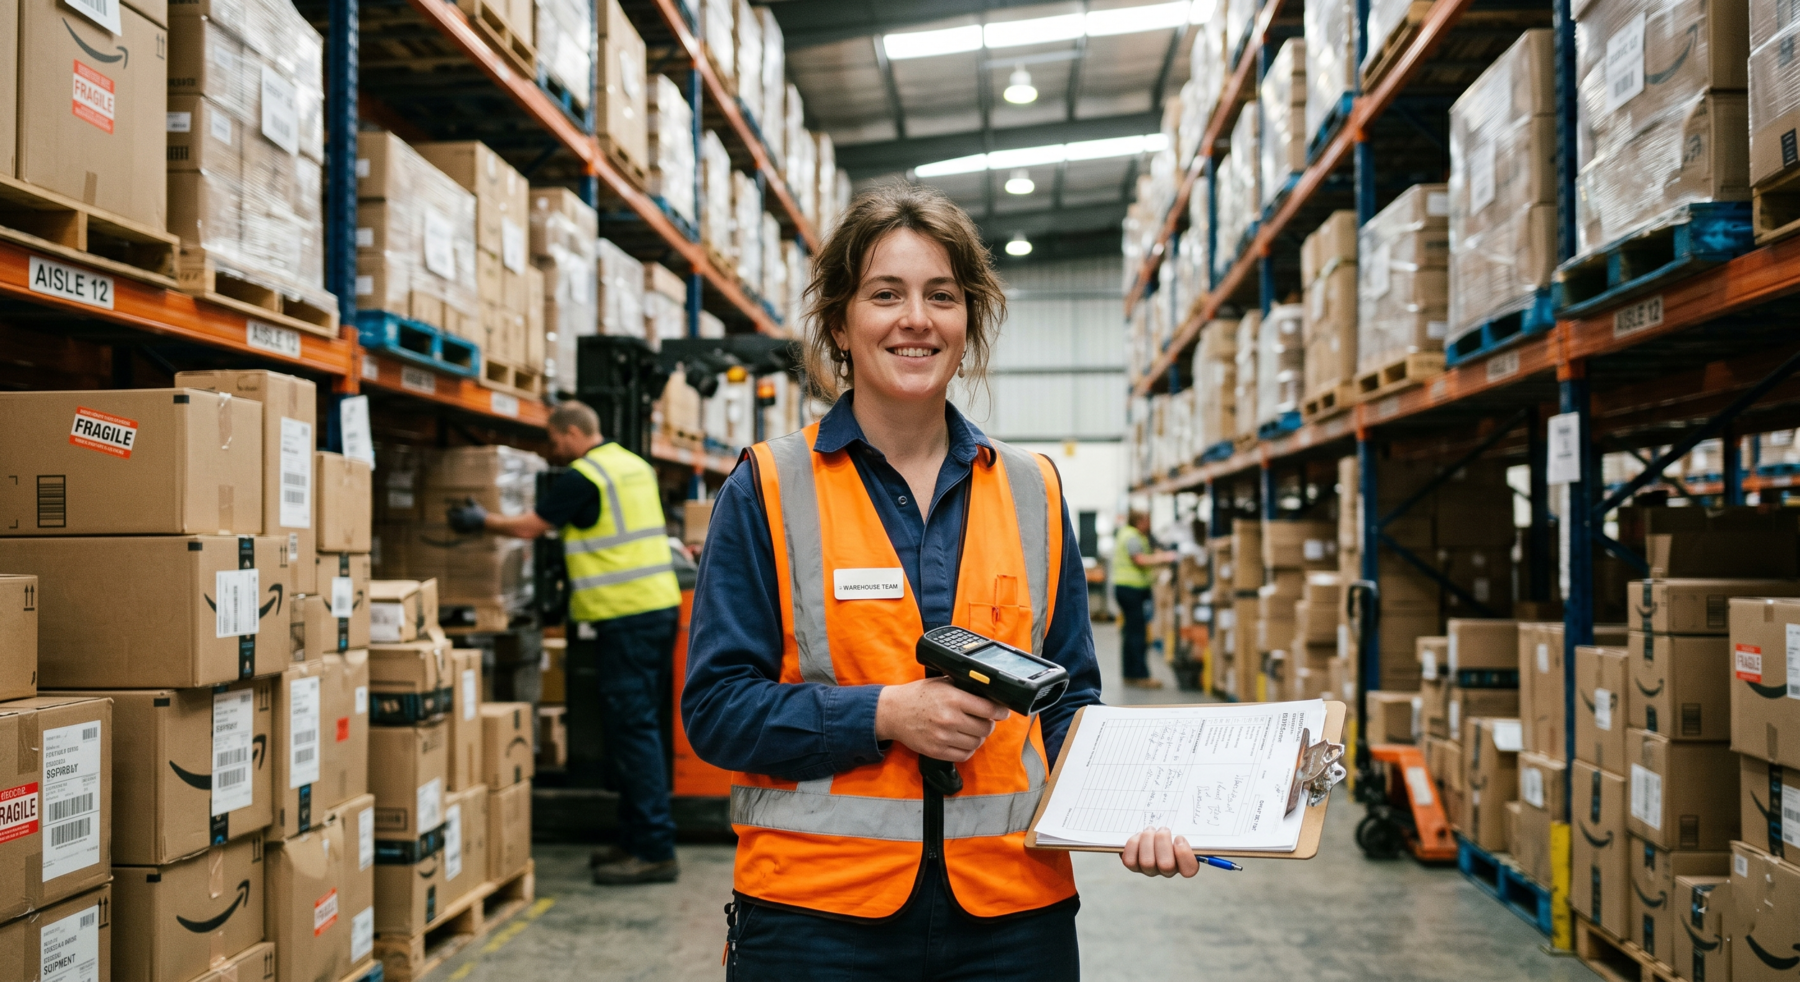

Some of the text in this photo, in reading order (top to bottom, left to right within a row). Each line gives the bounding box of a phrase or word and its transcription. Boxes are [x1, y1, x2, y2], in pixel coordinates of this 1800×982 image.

[75, 79, 113, 114] FRAGILE
[35, 263, 108, 302] AISLE 12
[1617, 303, 1645, 330] AISLE
[74, 417, 133, 447] FRAGILE
[0, 797, 36, 826] RAGILE
